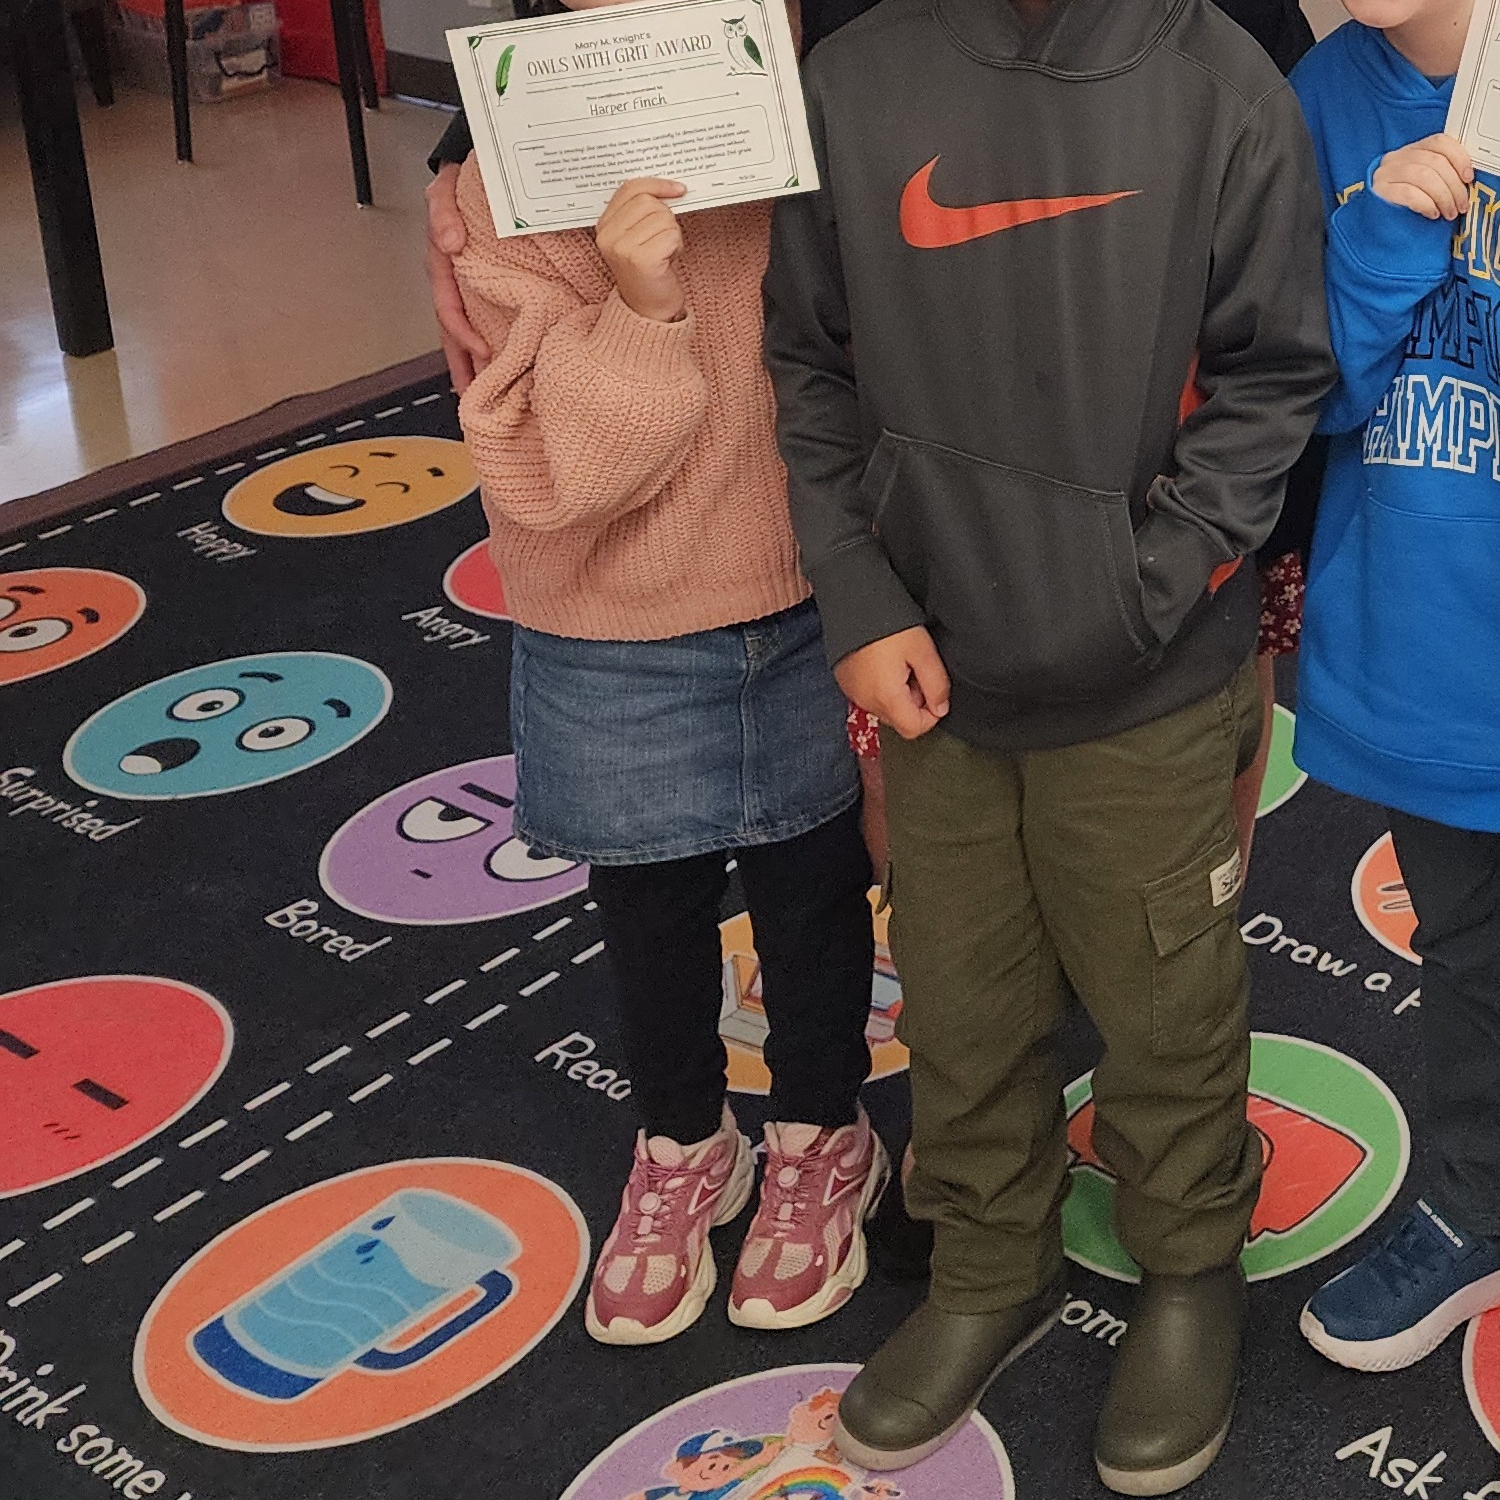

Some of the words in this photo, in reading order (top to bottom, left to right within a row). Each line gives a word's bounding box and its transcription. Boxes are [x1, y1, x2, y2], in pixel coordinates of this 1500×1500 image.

[527, 56, 570, 78] OWLS
[571, 50, 612, 71] WITH
[614, 44, 650, 65] GRIT
[654, 34, 712, 58] AWARD
[590, 99, 629, 117] Harper
[633, 92, 668, 109] Finch
[176, 520, 257, 562] Happy
[400, 606, 491, 650] Angry
[0, 764, 142, 844] Surprised
[263, 898, 393, 964] Bored
[1239, 911, 1359, 979] Draw
[1363, 967, 1394, 994] a
[56, 1424, 166, 1500] some
[1334, 1425, 1449, 1500] Ask
